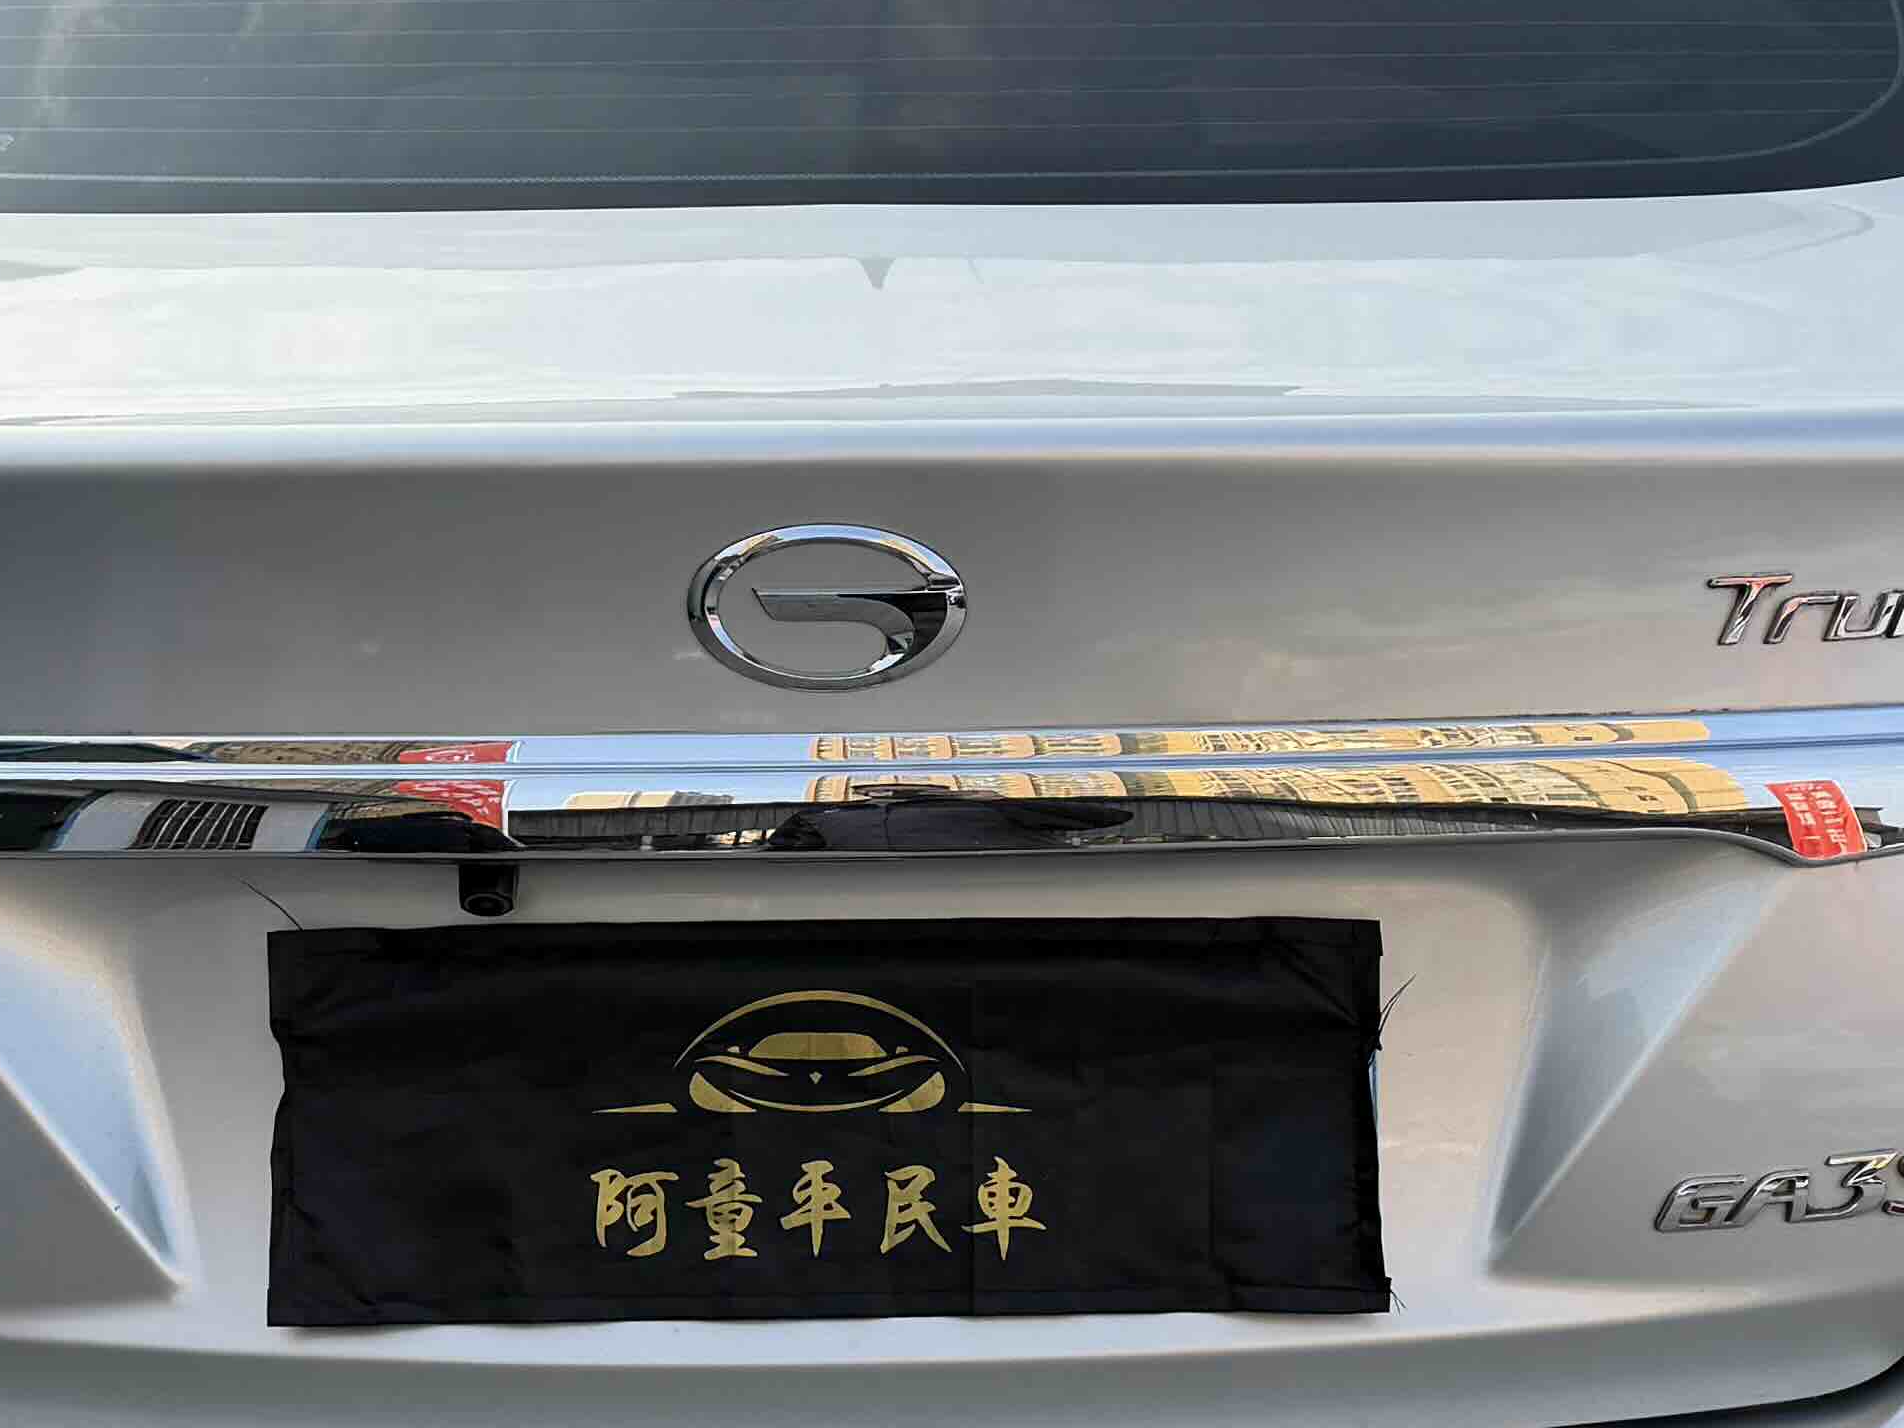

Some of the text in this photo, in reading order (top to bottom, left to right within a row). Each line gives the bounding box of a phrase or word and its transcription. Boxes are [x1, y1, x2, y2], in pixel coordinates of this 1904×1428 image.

[590, 1154, 1048, 1260] 阿童平民車
